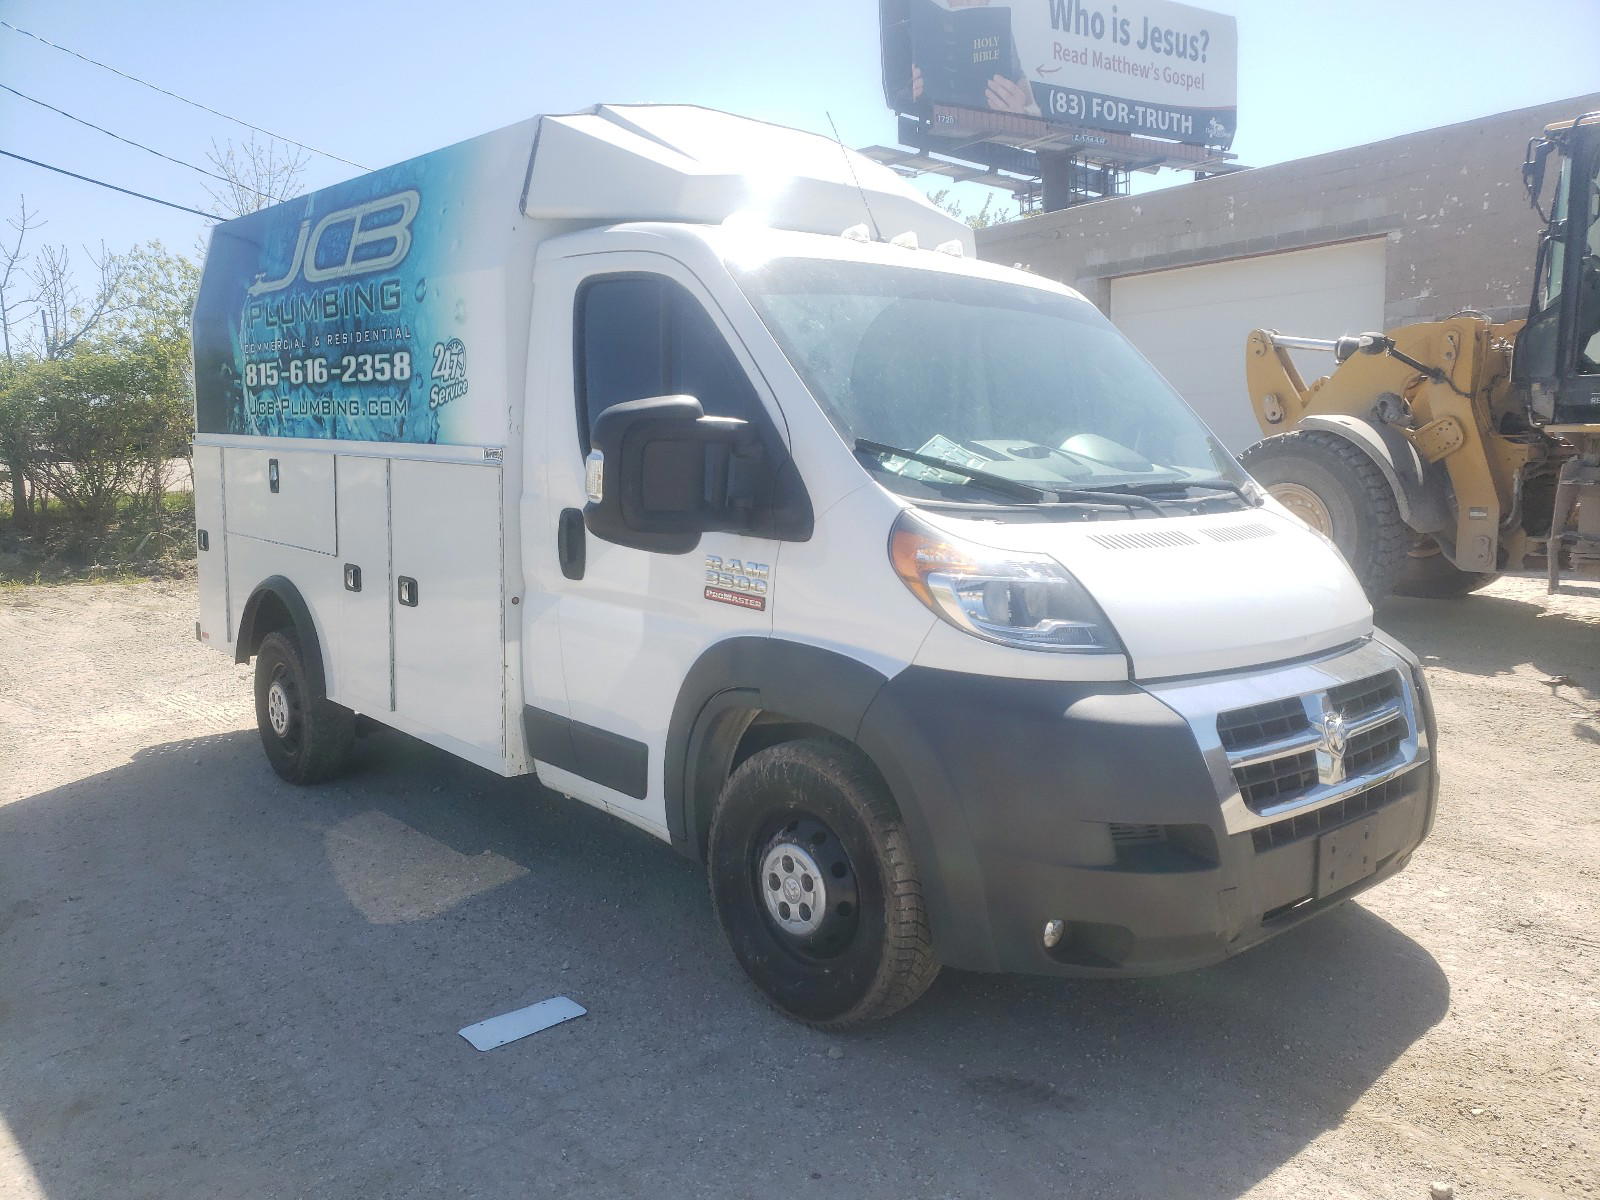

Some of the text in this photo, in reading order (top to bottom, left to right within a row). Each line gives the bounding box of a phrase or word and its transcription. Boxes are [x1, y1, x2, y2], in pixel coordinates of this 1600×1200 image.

[973, 35, 1000, 49] HOLY
[1049, 0, 1210, 63] Who is Jesus?
[973, 49, 1000, 64] BIBLE
[1053, 41, 1205, 91] Read Matthew's Gospel
[1050, 89, 1193, 135] (83) FOR-TRUTH
[250, 280, 401, 328] PLUMBING
[244, 327, 412, 354] COMMERCIAL & RESIDENTIAL
[246, 351, 411, 387] 815-616-2358
[430, 378, 469, 410] Service
[704, 554, 770, 579] RAM
[704, 570, 768, 594] 3500
